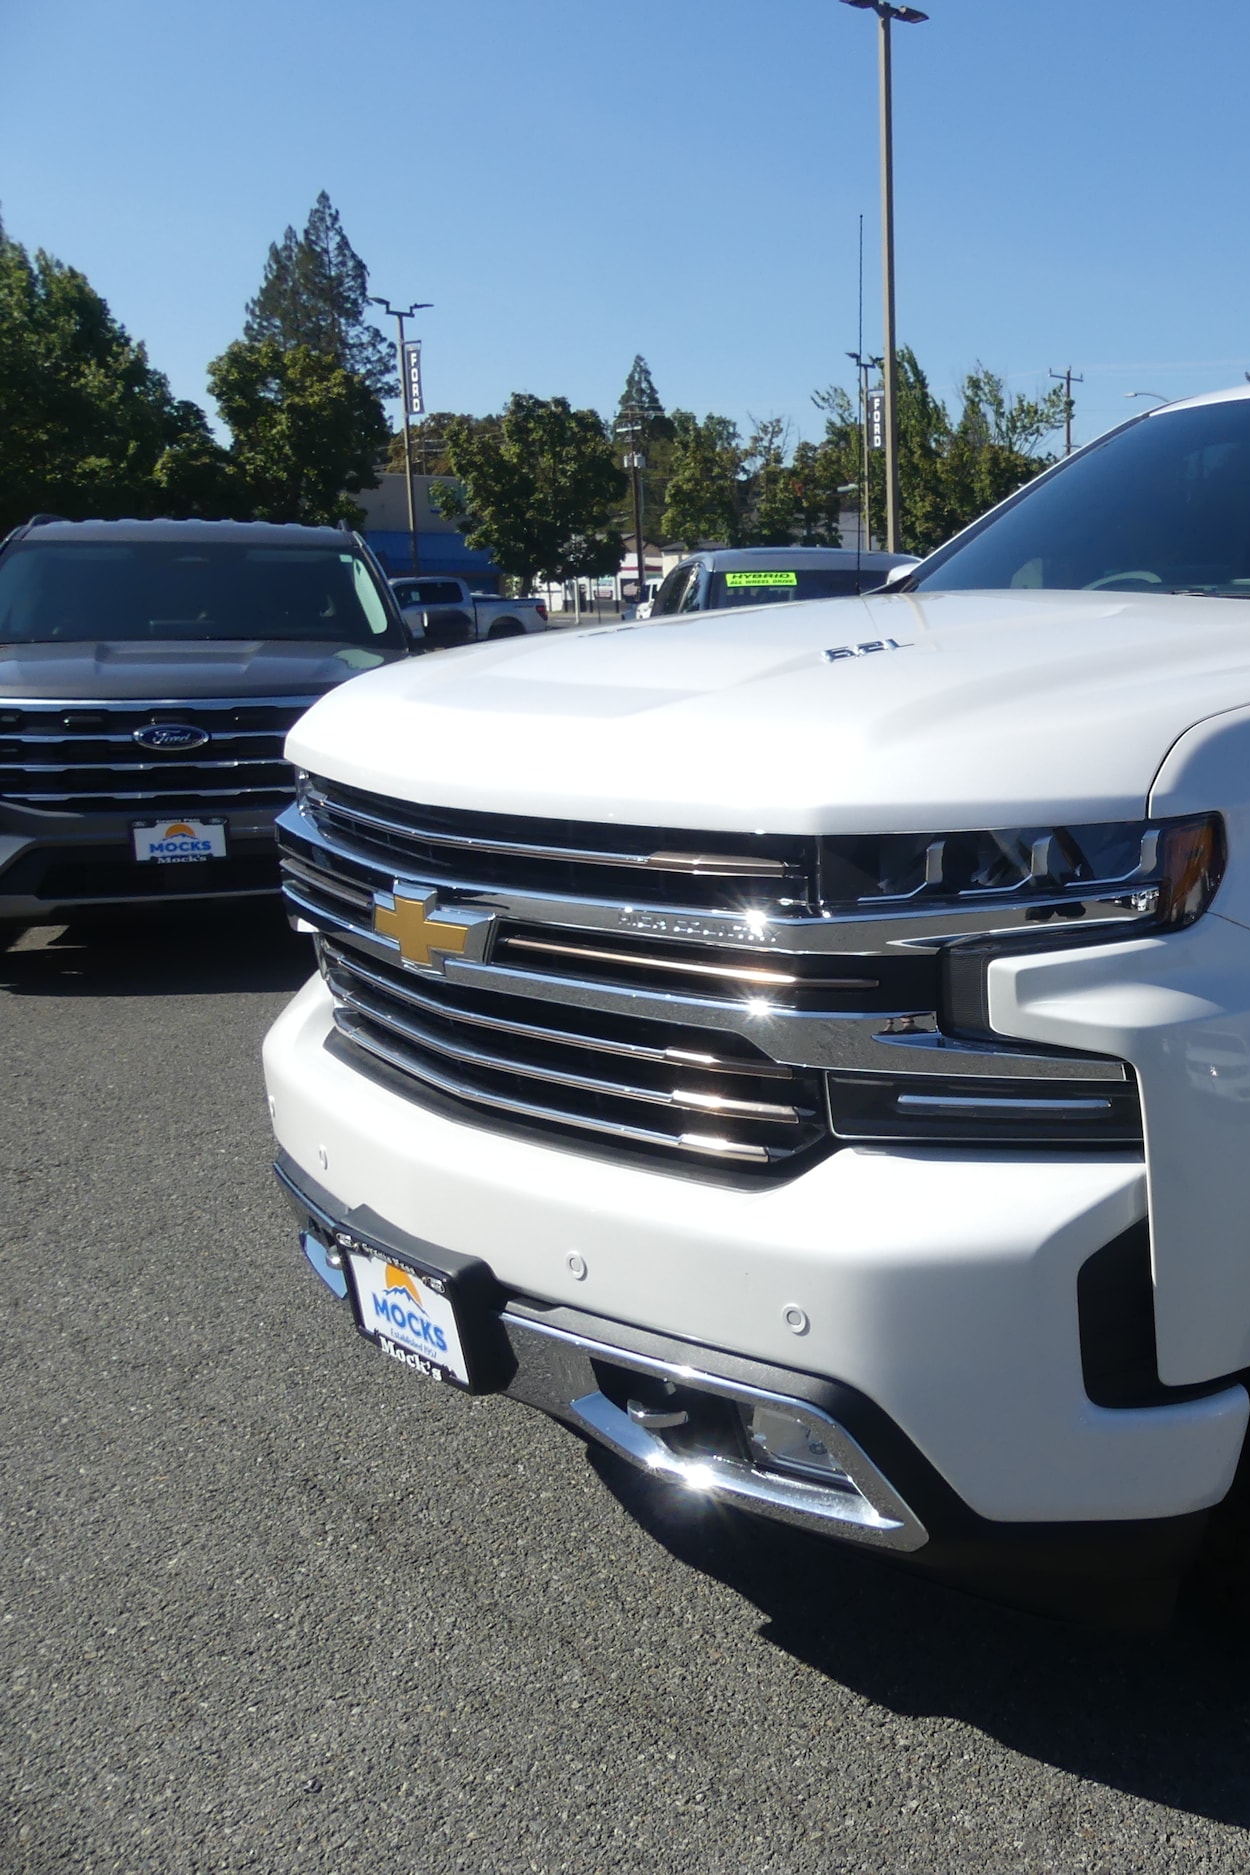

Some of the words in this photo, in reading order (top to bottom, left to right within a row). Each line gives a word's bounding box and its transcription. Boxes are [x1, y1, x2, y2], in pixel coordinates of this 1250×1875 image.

[410, 352, 420, 412] FORD
[873, 398, 881, 448] FORD
[152, 729, 192, 744] Ford
[149, 841, 212, 854] MOCKS
[157, 855, 207, 864] Mock's
[618, 912, 667, 931] HIGH
[673, 918, 782, 943] COUNTRY
[371, 1291, 448, 1353] MOCKS
[390, 1327, 423, 1350] Established
[378, 1336, 443, 1382] Mock's
